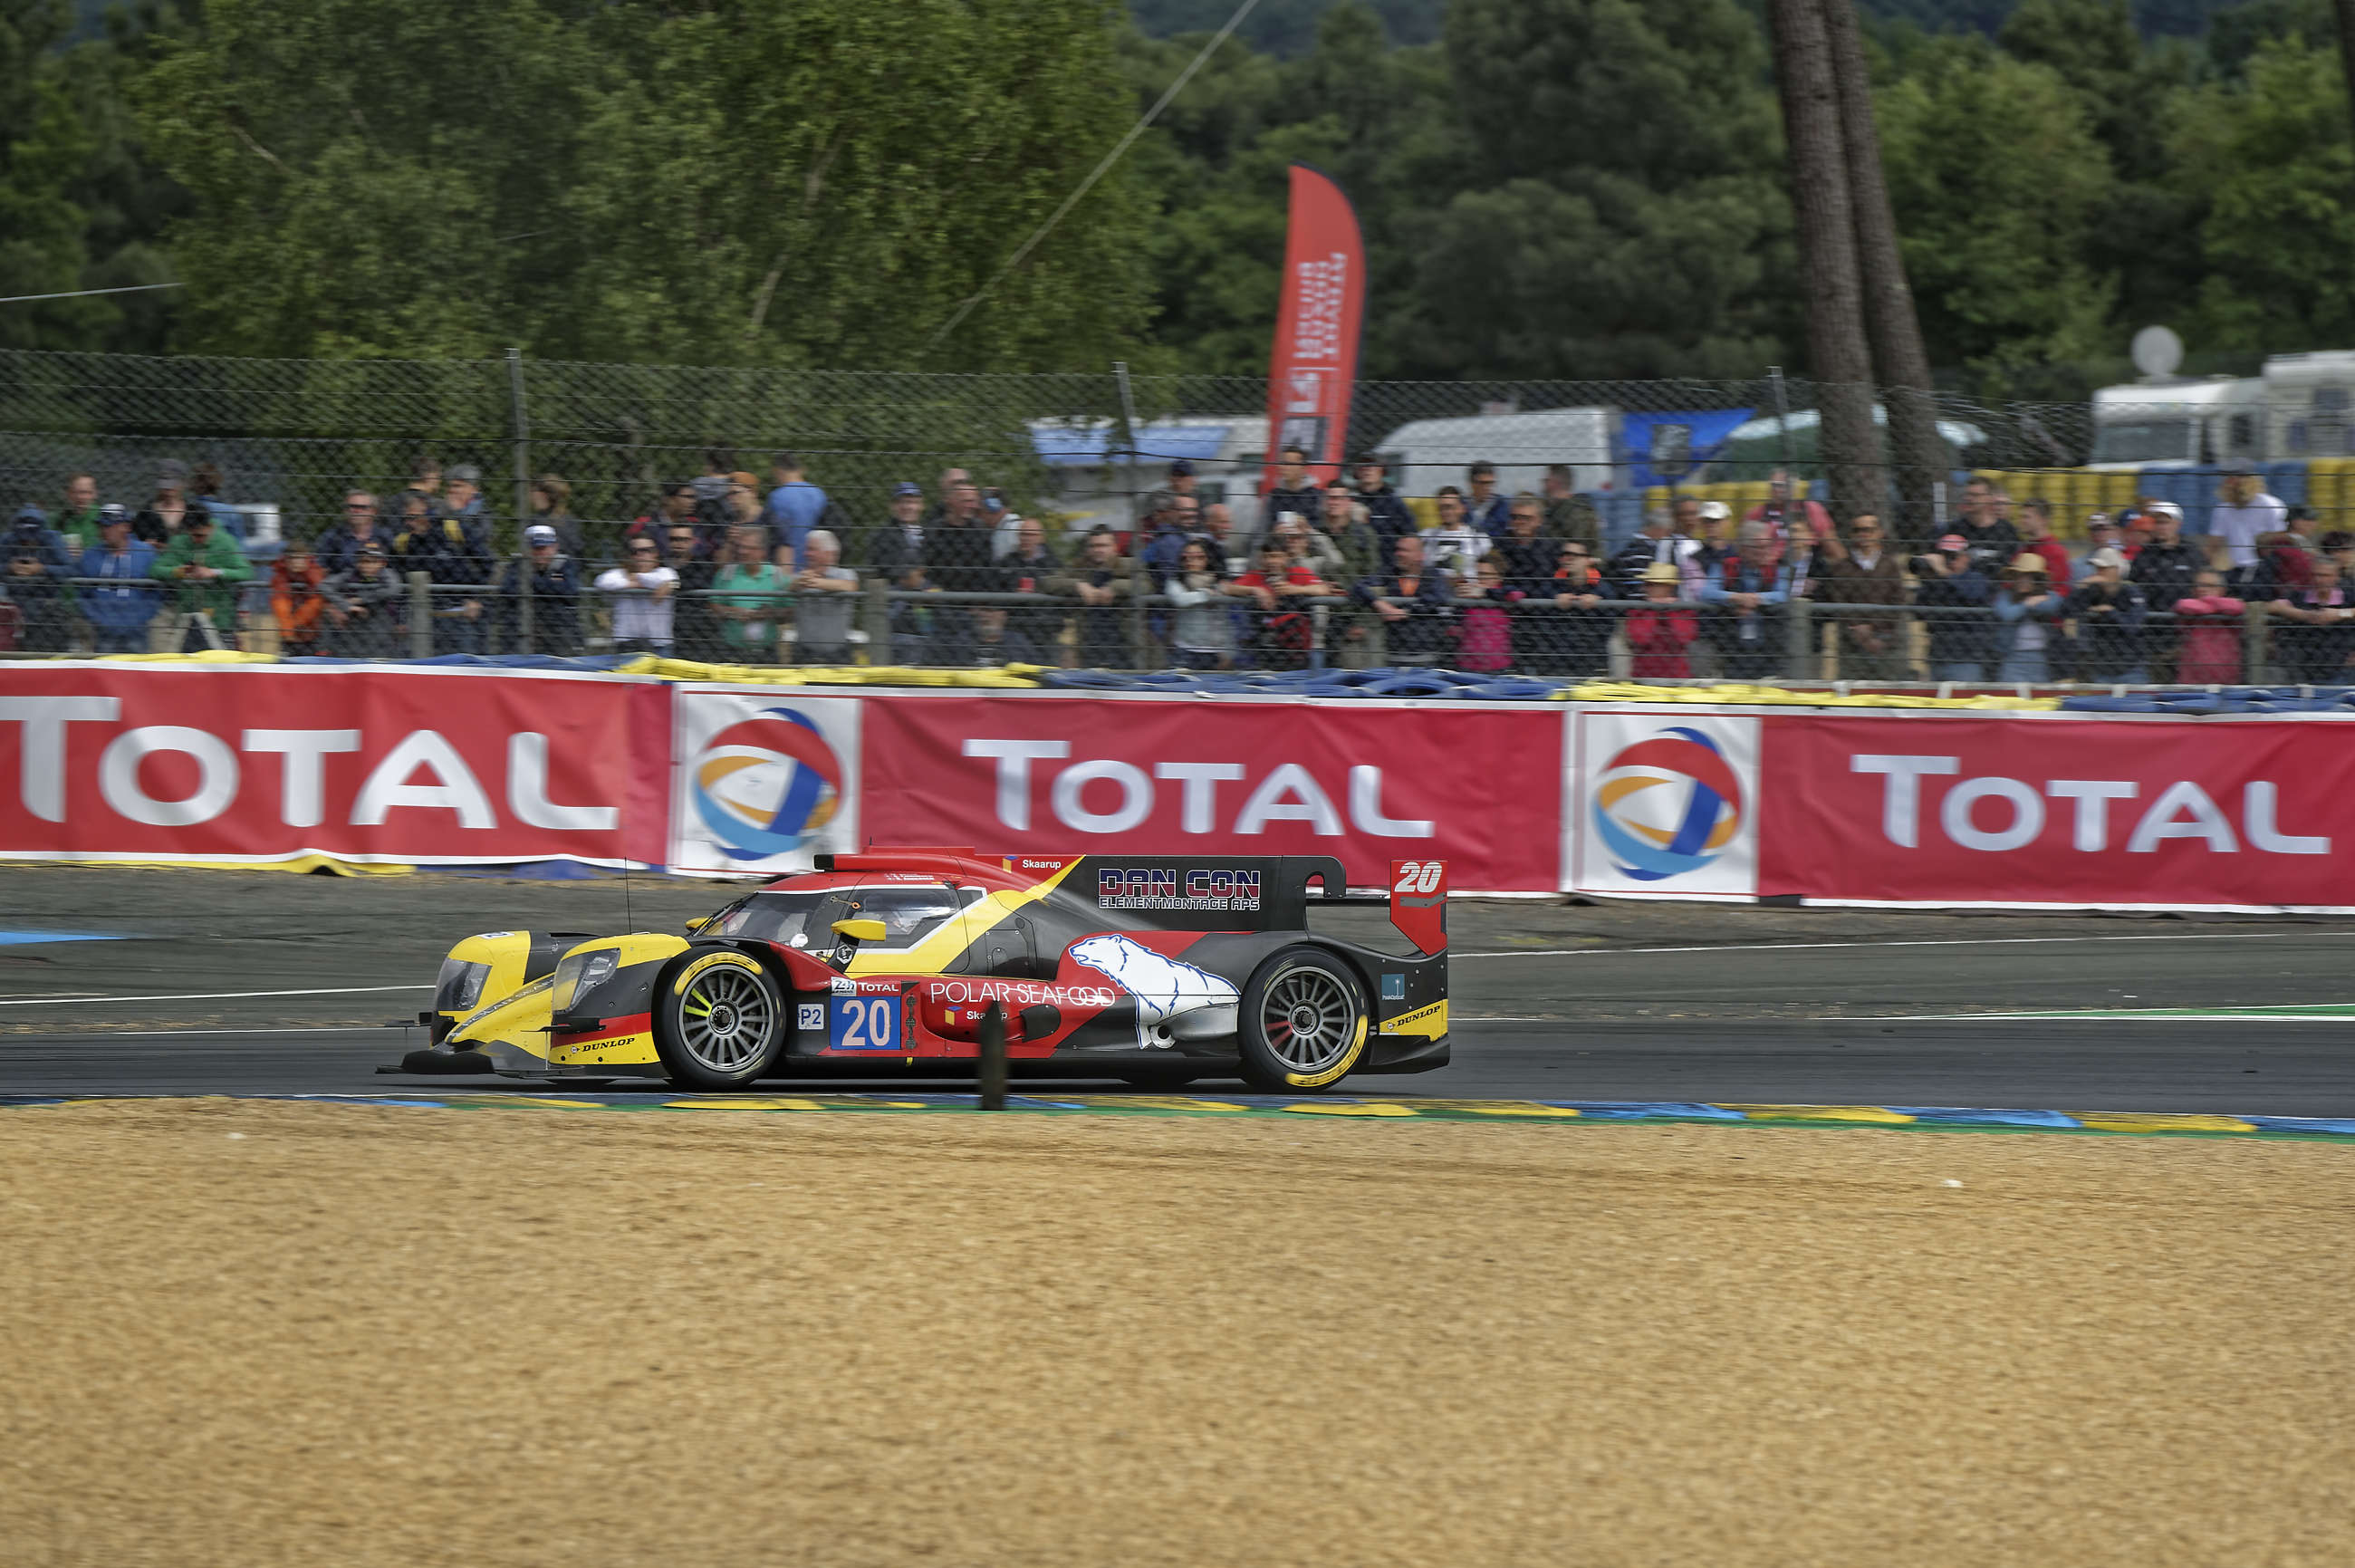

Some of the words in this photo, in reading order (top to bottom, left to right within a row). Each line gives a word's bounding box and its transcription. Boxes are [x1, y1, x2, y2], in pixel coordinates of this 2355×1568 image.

[0, 695, 620, 830] TOTAL
[962, 739, 1435, 838] TOTAL
[1850, 754, 2332, 854] TOTAL
[1022, 859, 1062, 870] Skaarup
[1394, 861, 1443, 893] 20
[1098, 868, 1177, 897] DAN
[1186, 870, 1261, 899] CON
[1098, 897, 1228, 910] ELEMENTMONTAGE
[1230, 898, 1261, 911] APS
[858, 982, 899, 992] TOTAL
[930, 982, 1011, 1004] POLAR
[1016, 983, 1116, 1007] SEAFOOD
[801, 1008, 822, 1024] P2
[841, 999, 890, 1046] 20
[1397, 1005, 1441, 1026] DUNLOP
[582, 1037, 635, 1052] DUNLOP
